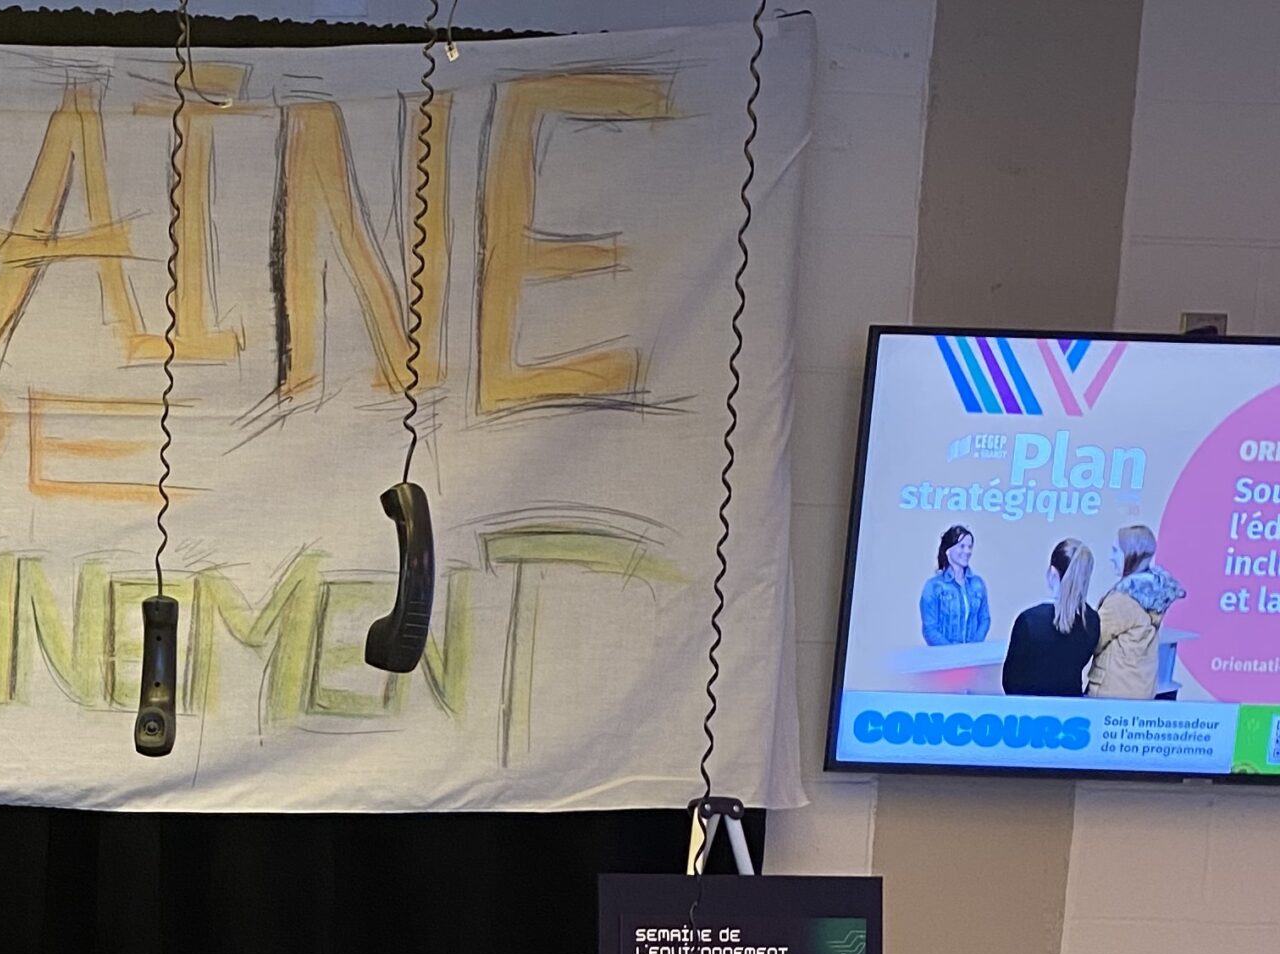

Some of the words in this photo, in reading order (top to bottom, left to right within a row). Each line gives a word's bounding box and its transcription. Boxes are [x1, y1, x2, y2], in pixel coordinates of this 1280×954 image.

[1011, 430, 1147, 489] Plan
[898, 479, 1102, 522] stratégique
[1225, 547, 1280, 576] incl
[1220, 588, 1250, 613] et
[853, 710, 1091, 750] CONCOURS
[1103, 731, 1117, 740] ou
[1121, 729, 1211, 742] l'ambassadrice
[1104, 715, 1128, 727] Sois
[1132, 716, 1219, 730] l'ambassadeur
[1101, 742, 1116, 752] de
[1120, 743, 1139, 753] ton
[1142, 745, 1214, 757] programme
